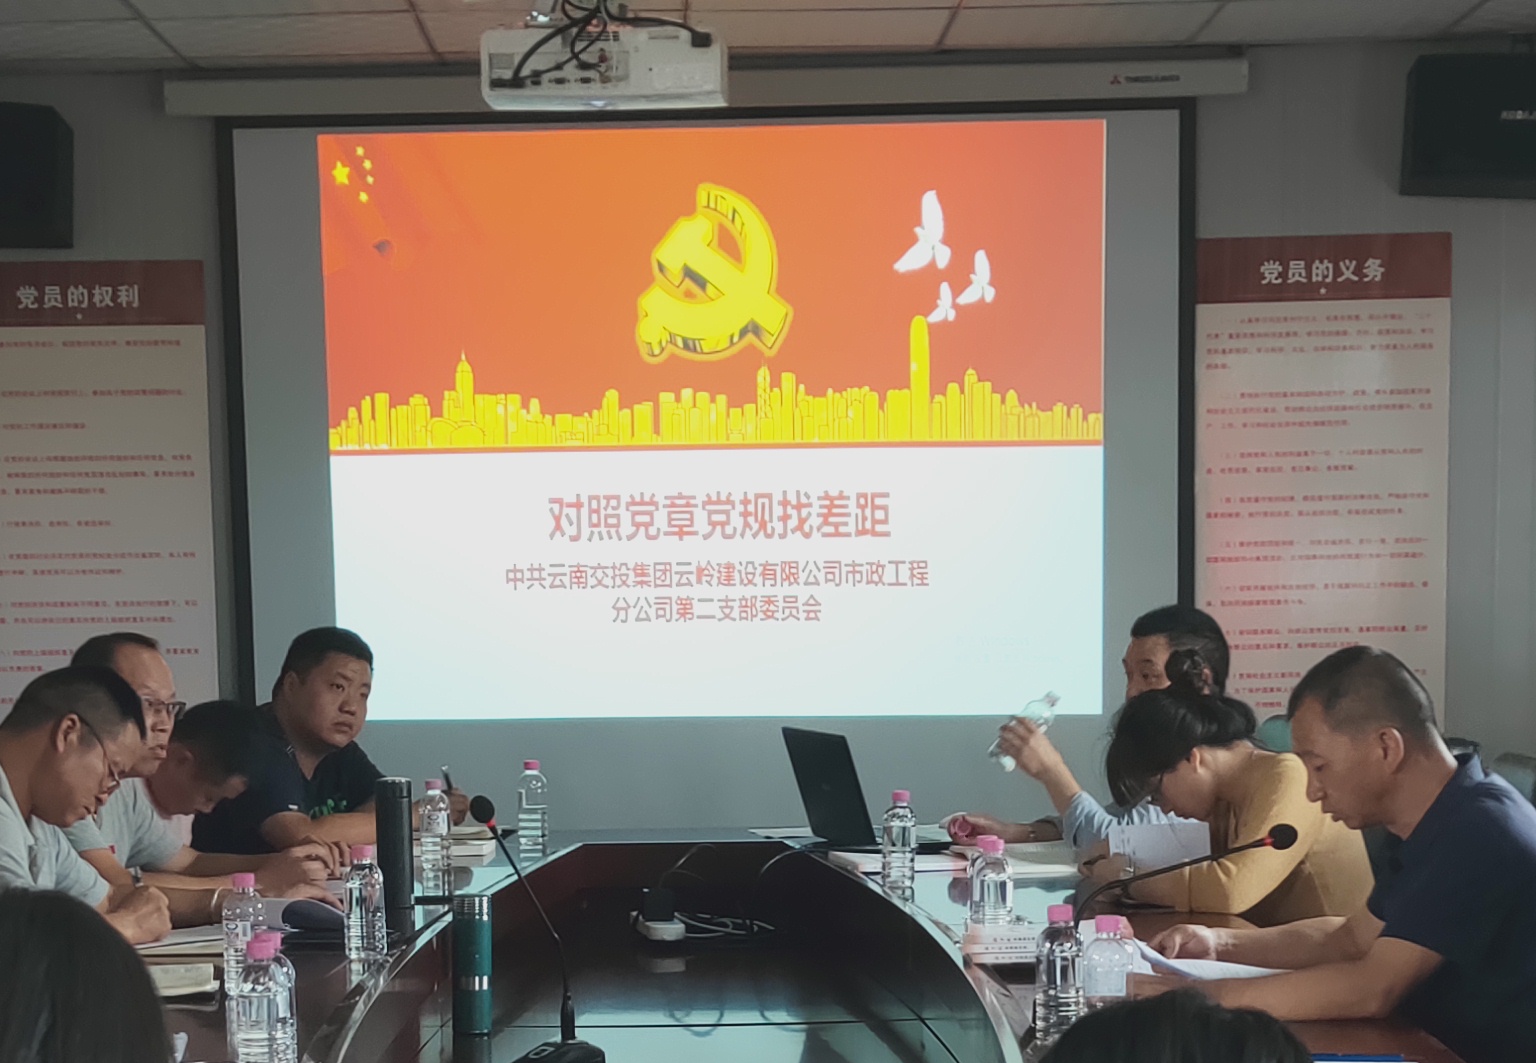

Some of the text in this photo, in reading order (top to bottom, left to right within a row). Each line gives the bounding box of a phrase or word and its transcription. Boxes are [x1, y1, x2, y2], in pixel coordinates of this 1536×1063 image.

[1260, 258, 1387, 285] 党员的义务
[16, 284, 140, 310] 党员的权利
[547, 490, 892, 542] 对照党章党规找差距
[505, 559, 930, 591] 中共云南交投集团云岭建设有限公司市政工程
[611, 593, 822, 624] 分公司第二支部委员会
